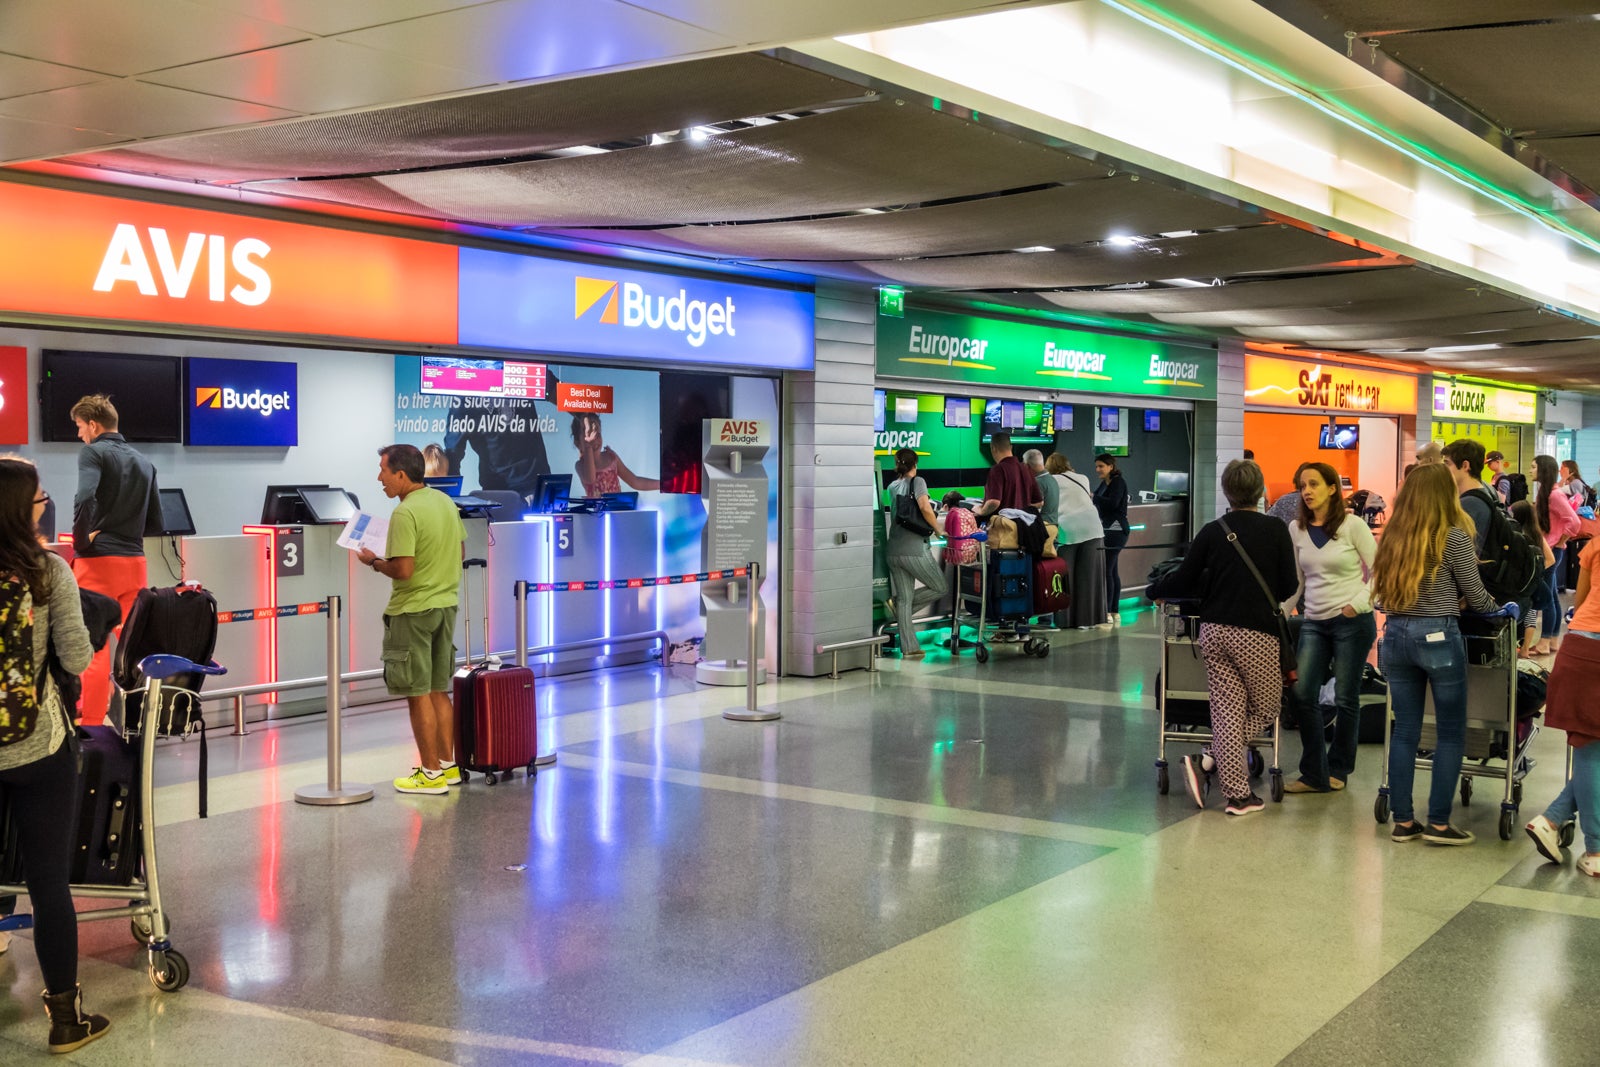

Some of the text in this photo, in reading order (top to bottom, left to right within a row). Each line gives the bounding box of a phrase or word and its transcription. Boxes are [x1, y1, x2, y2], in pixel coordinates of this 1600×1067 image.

[92, 222, 272, 306] AVIS
[623, 282, 736, 347] Budget
[908, 325, 989, 366] Europcar
[1043, 342, 1106, 378] Europcar
[1149, 354, 1199, 385] Europcar
[536, 367, 541, 375] 1
[536, 378, 541, 386] 1
[570, 387, 601, 398] Best Deal
[223, 387, 290, 417] Budget
[397, 392, 409, 409] to
[412, 391, 430, 409] the
[433, 395, 461, 409] AVIS
[535, 389, 541, 397] 2
[1335, 380, 1354, 408] rent
[1366, 386, 1380, 410] car
[1450, 390, 1486, 413] GOLDCAR
[563, 398, 607, 410] Available Now
[431, 418, 446, 433] ao
[449, 415, 475, 433] lado
[477, 415, 507, 433] AVIS
[509, 415, 527, 433] da
[529, 415, 559, 433] vida.
[721, 421, 758, 435] AVIS
[731, 434, 758, 444] Budget
[874, 430, 923, 455] ropcar
[558, 529, 569, 550] 5
[283, 542, 298, 568] 3
[217, 613, 229, 621] VIS
[258, 609, 273, 617] AVIS
[302, 604, 316, 612] AVIS
